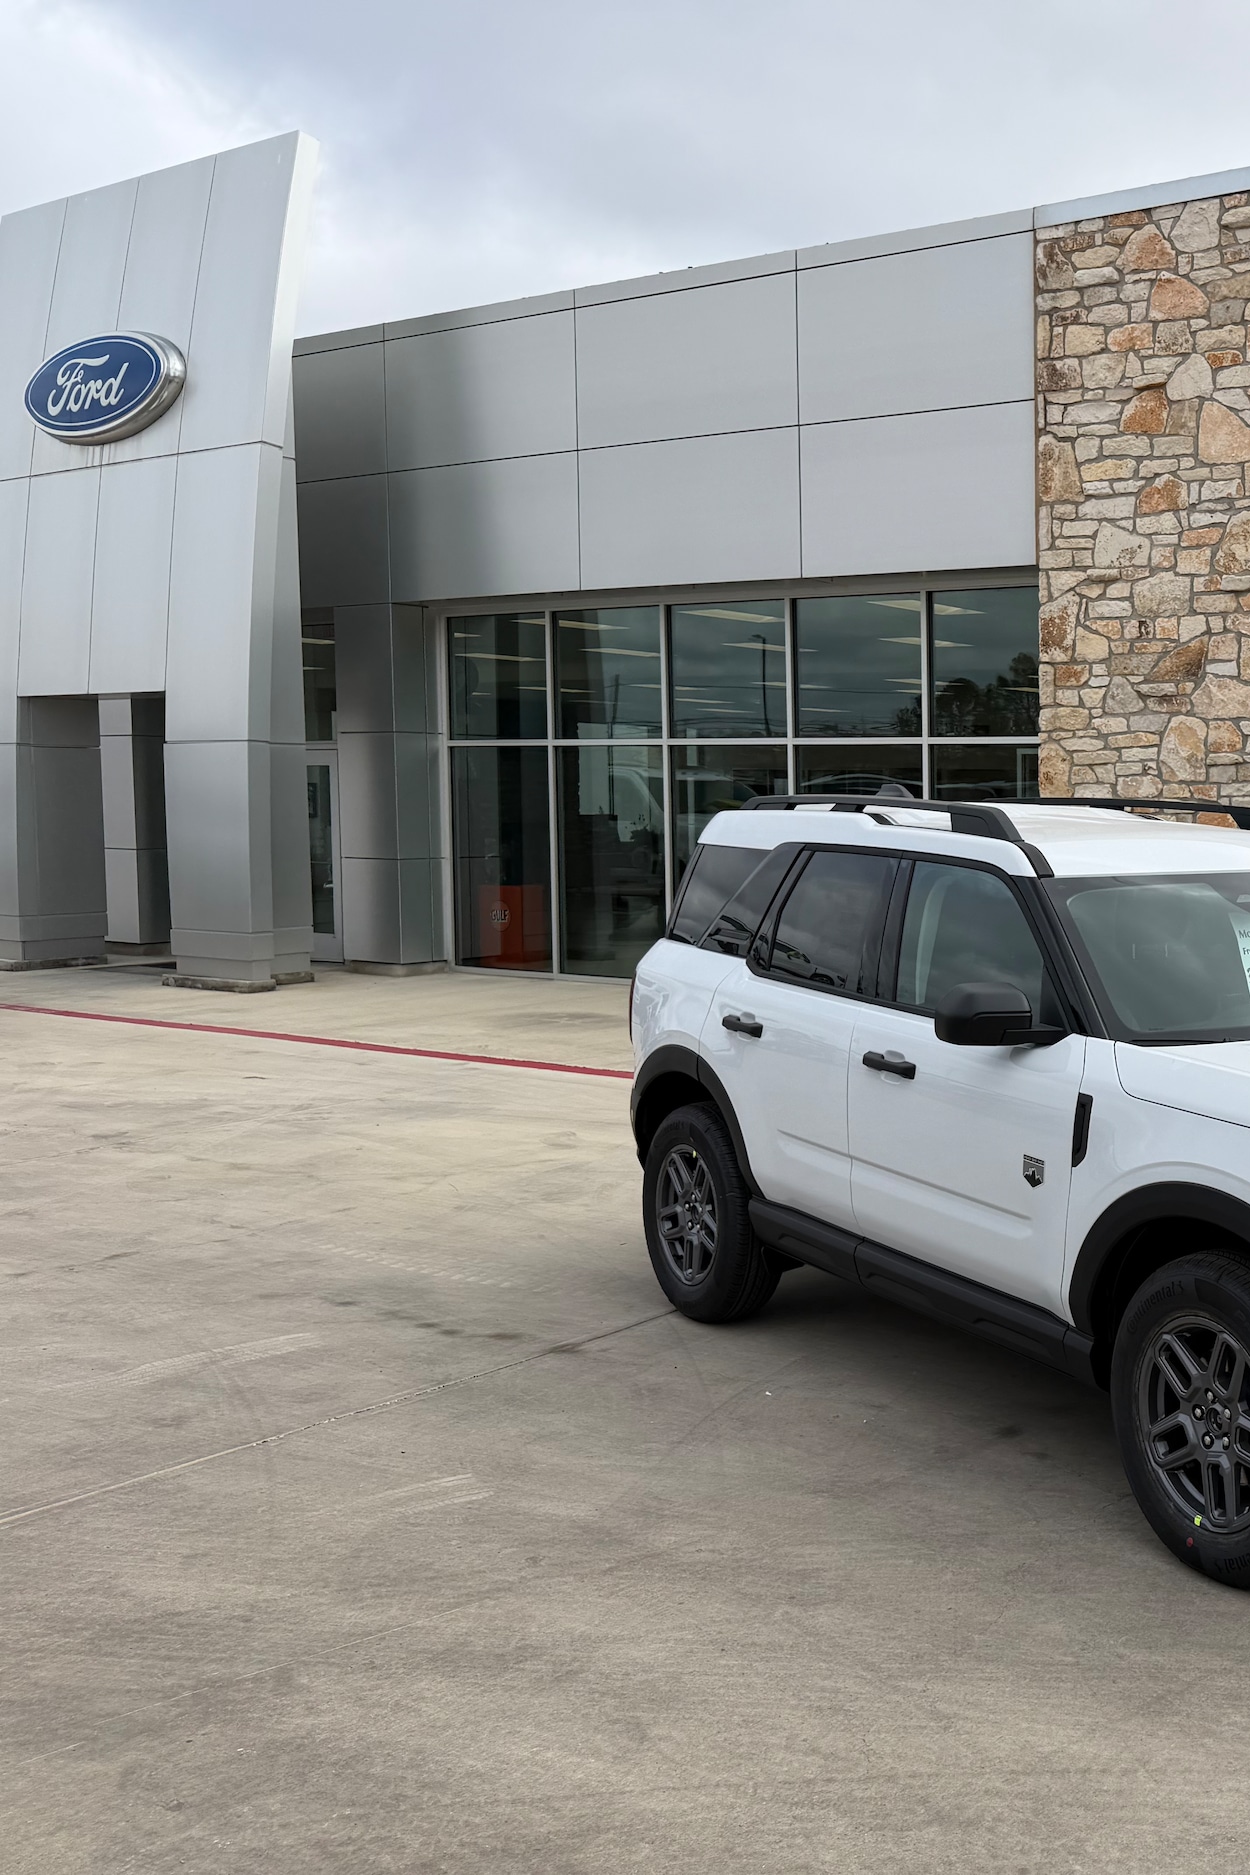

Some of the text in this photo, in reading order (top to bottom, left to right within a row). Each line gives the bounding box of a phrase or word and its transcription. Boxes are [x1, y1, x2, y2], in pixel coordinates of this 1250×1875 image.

[47, 354, 129, 417] Ford
[490, 909, 509, 922] GULF
[1127, 1280, 1176, 1335] Continental
